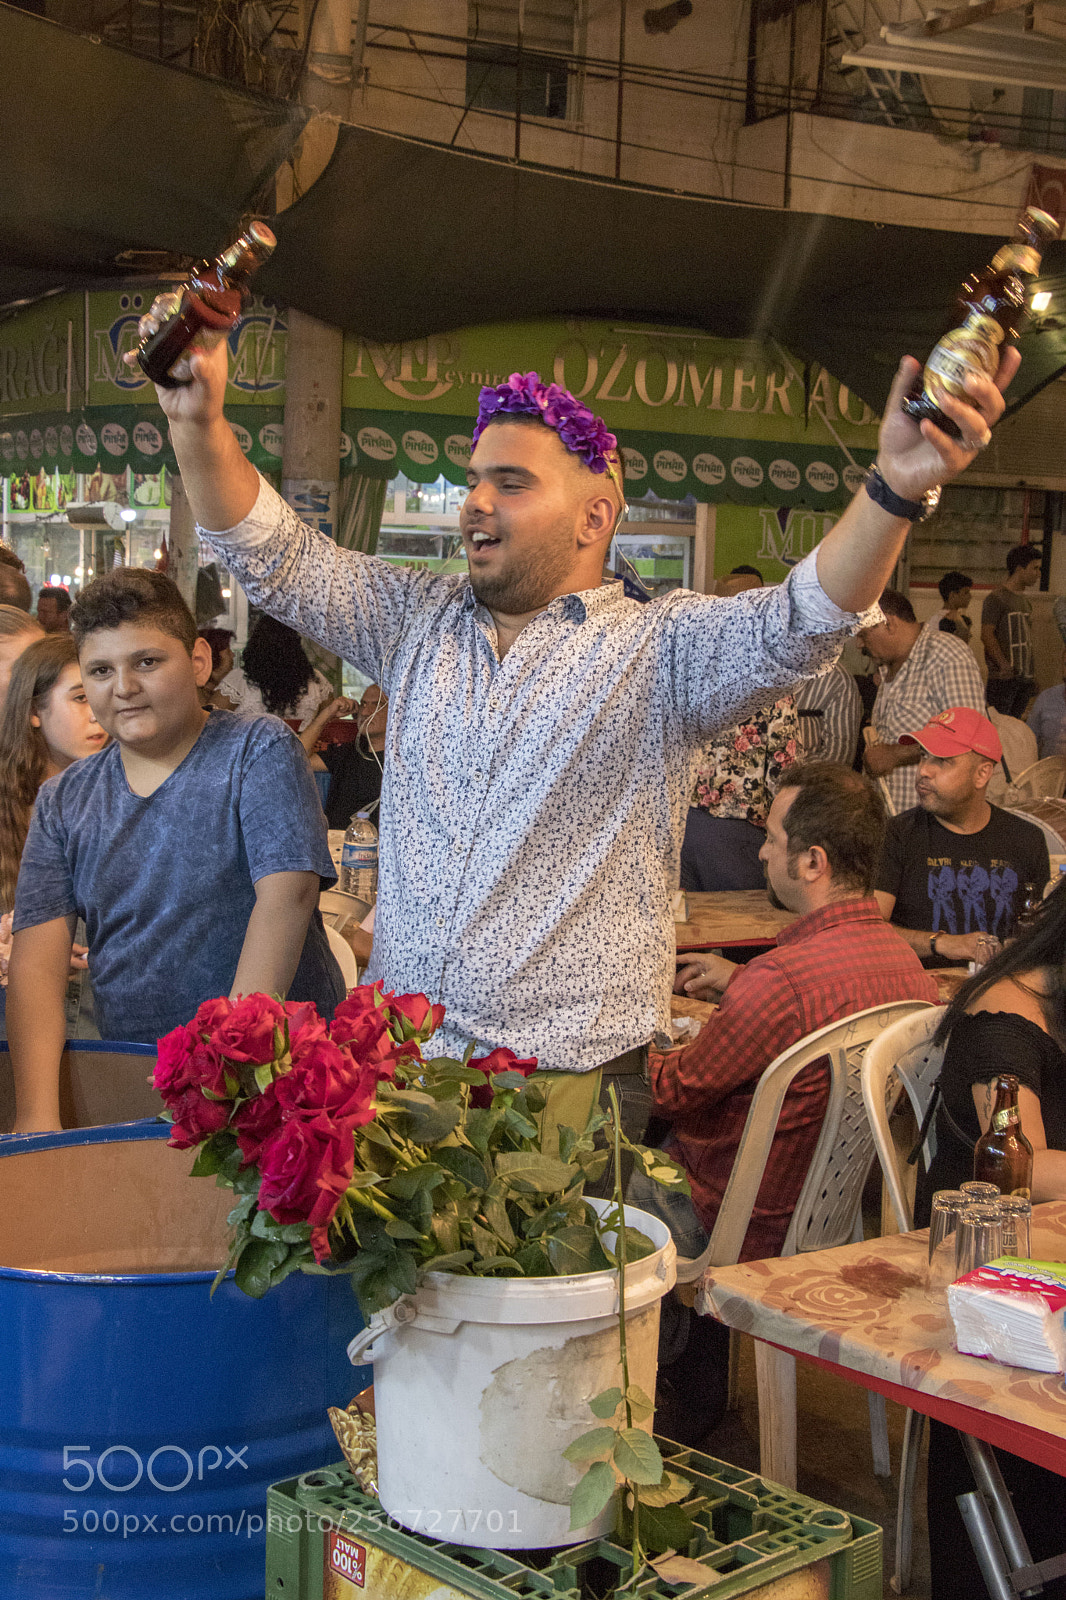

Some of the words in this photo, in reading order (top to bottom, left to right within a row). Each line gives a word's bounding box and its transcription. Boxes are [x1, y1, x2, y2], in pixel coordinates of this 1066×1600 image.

[360, 437, 393, 449] PINAR
[404, 440, 435, 453] PINAR
[447, 443, 473, 456] PINA
[335, 1538, 359, 1560] MALT
[332, 1548, 363, 1581] %100
